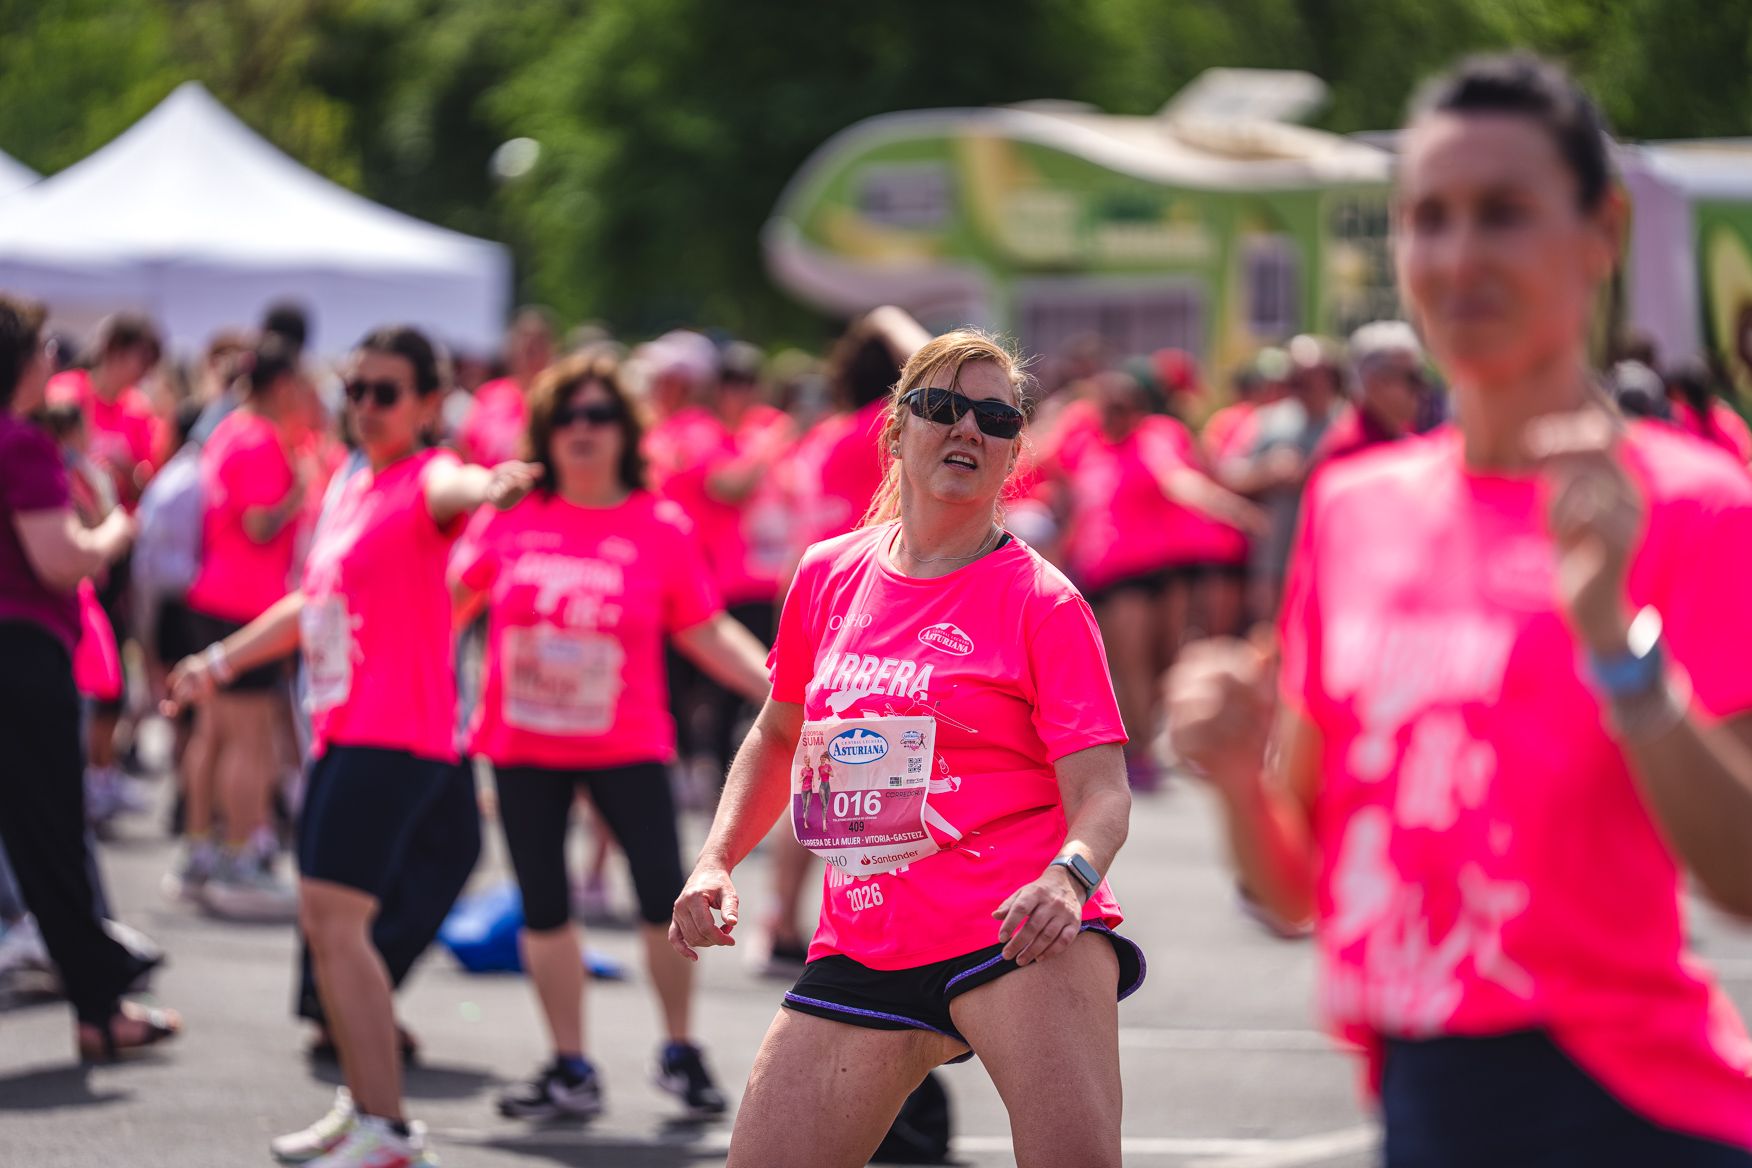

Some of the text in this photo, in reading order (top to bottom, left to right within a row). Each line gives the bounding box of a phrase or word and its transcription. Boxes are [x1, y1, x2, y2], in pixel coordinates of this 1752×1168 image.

[812, 651, 935, 701] ARRERA
[802, 736, 825, 747] SUMA
[833, 742, 885, 757] ASTURIANA
[833, 790, 882, 818] 016
[848, 821, 865, 832] 409
[823, 838, 832, 847] DE
[832, 838, 841, 846] LA
[840, 836, 861, 846] MUJER
[864, 831, 924, 844] VITORIA-GASTEIZ
[871, 849, 919, 865] Santander
[846, 882, 884, 912] 2026
